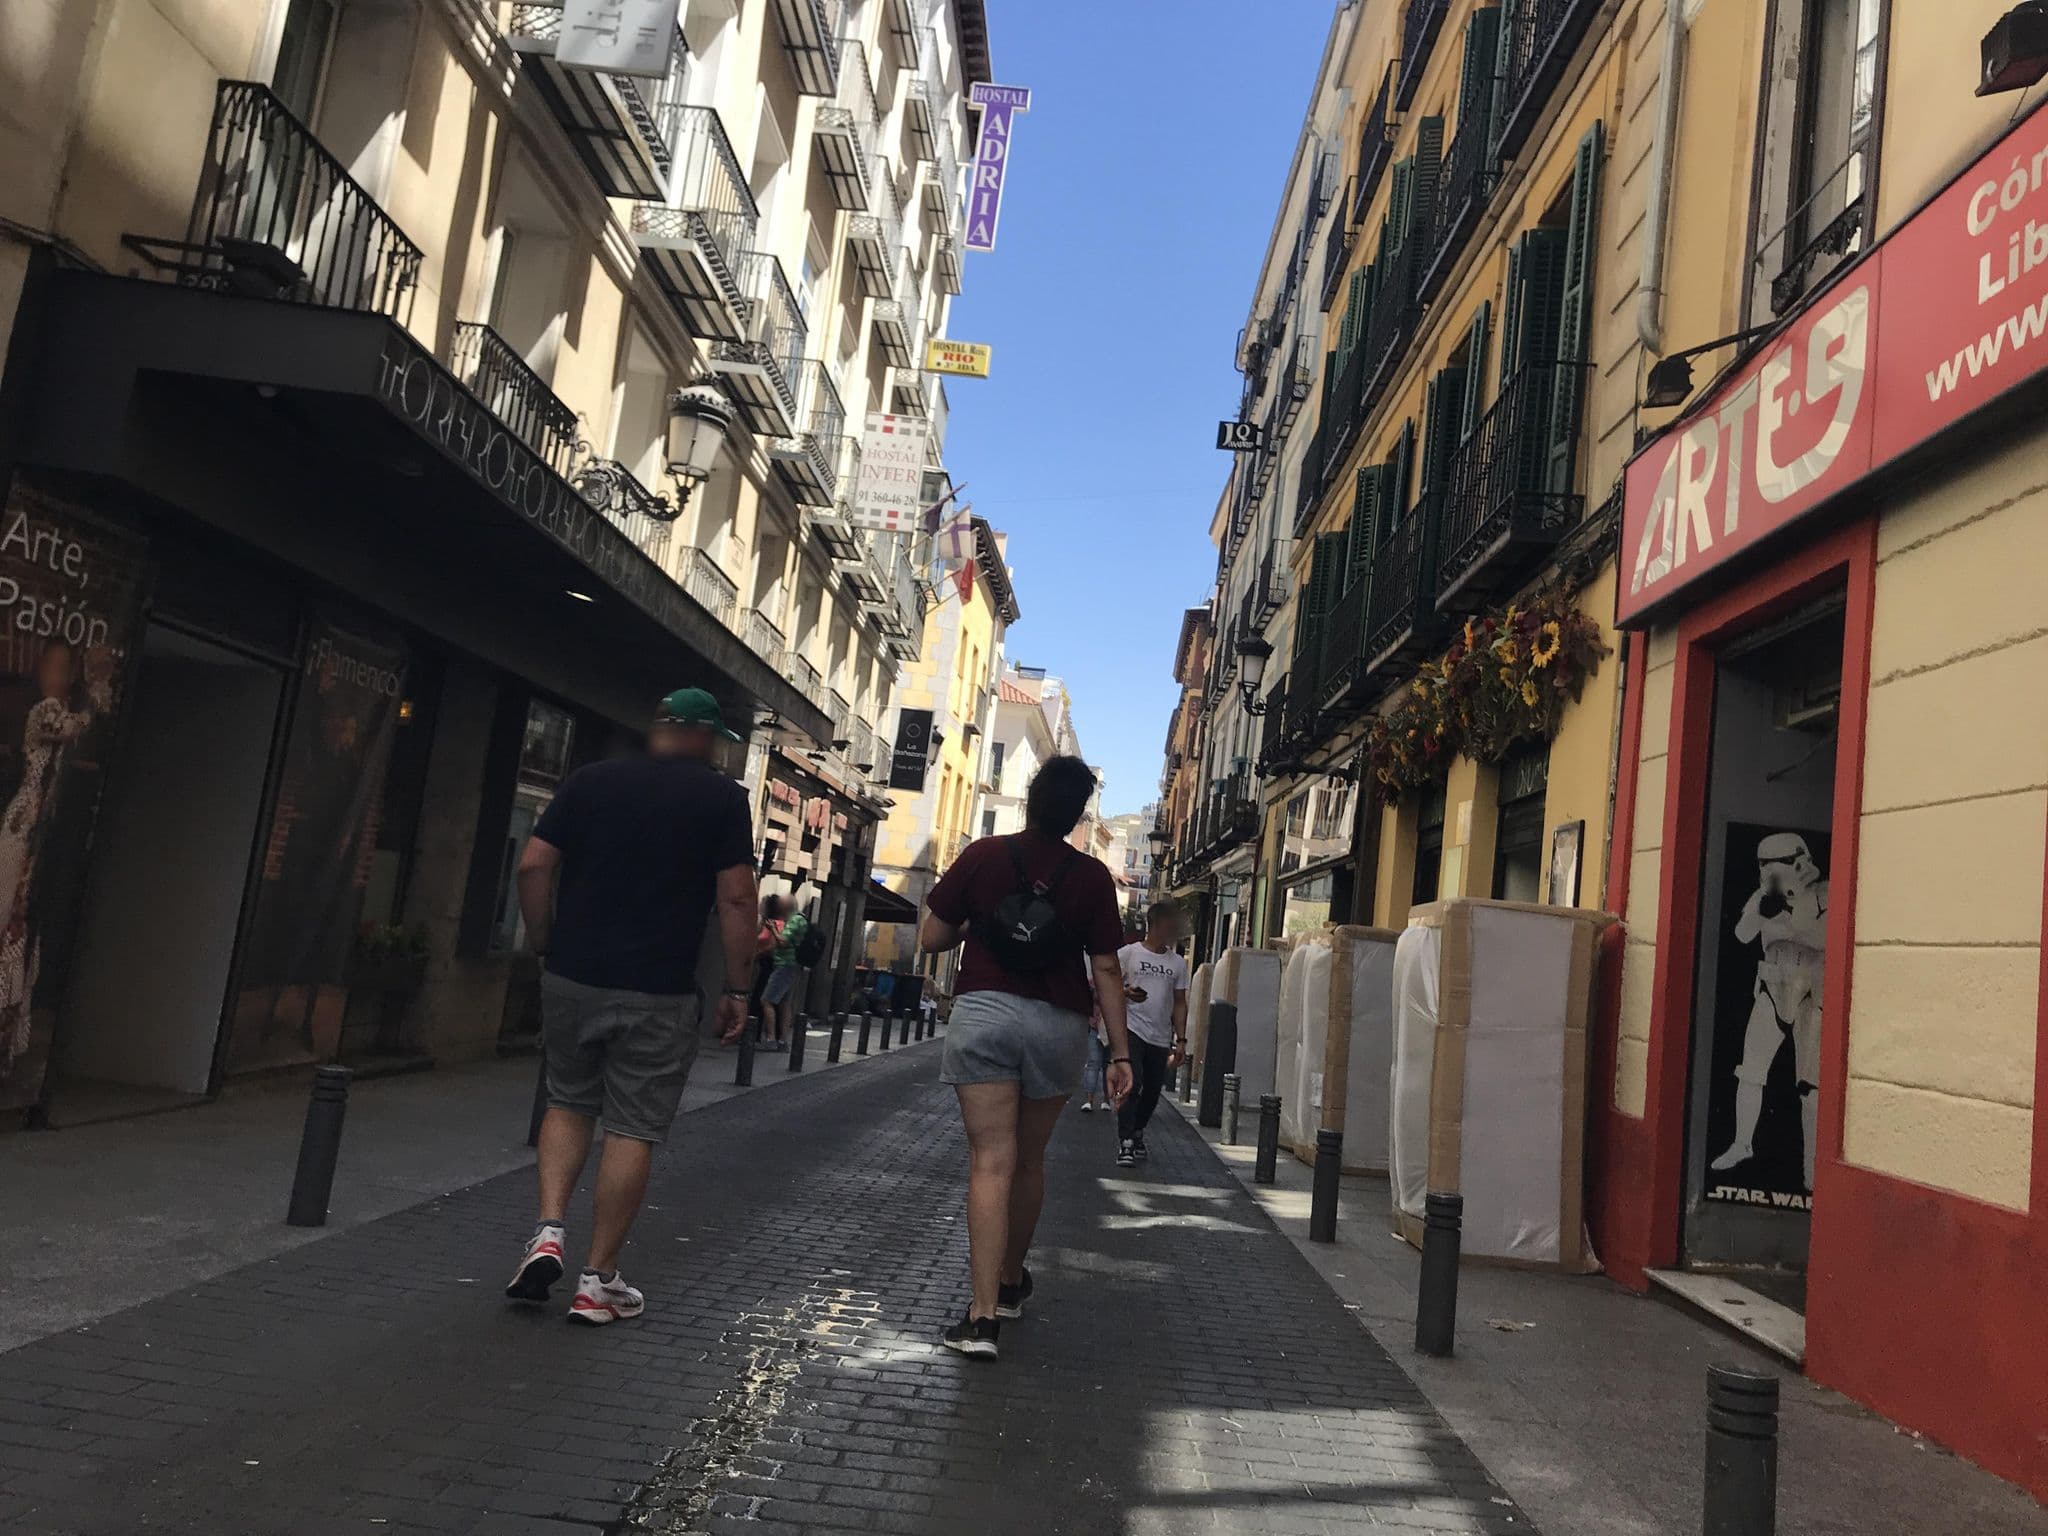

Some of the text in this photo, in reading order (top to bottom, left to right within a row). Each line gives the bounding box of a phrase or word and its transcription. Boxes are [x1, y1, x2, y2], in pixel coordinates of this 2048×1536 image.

[974, 86, 1026, 105] HOSTAL
[968, 112, 1007, 244] ADRIA
[933, 342, 965, 353] HOSTAL
[943, 351, 974, 364] RIO
[1222, 423, 1250, 446] JQ
[866, 448, 916, 463] HOSTAL
[862, 463, 917, 484] INTER
[1, 512, 88, 589] Arte,
[1140, 961, 1173, 976] Polo
[1707, 1185, 1769, 1204] STAR
